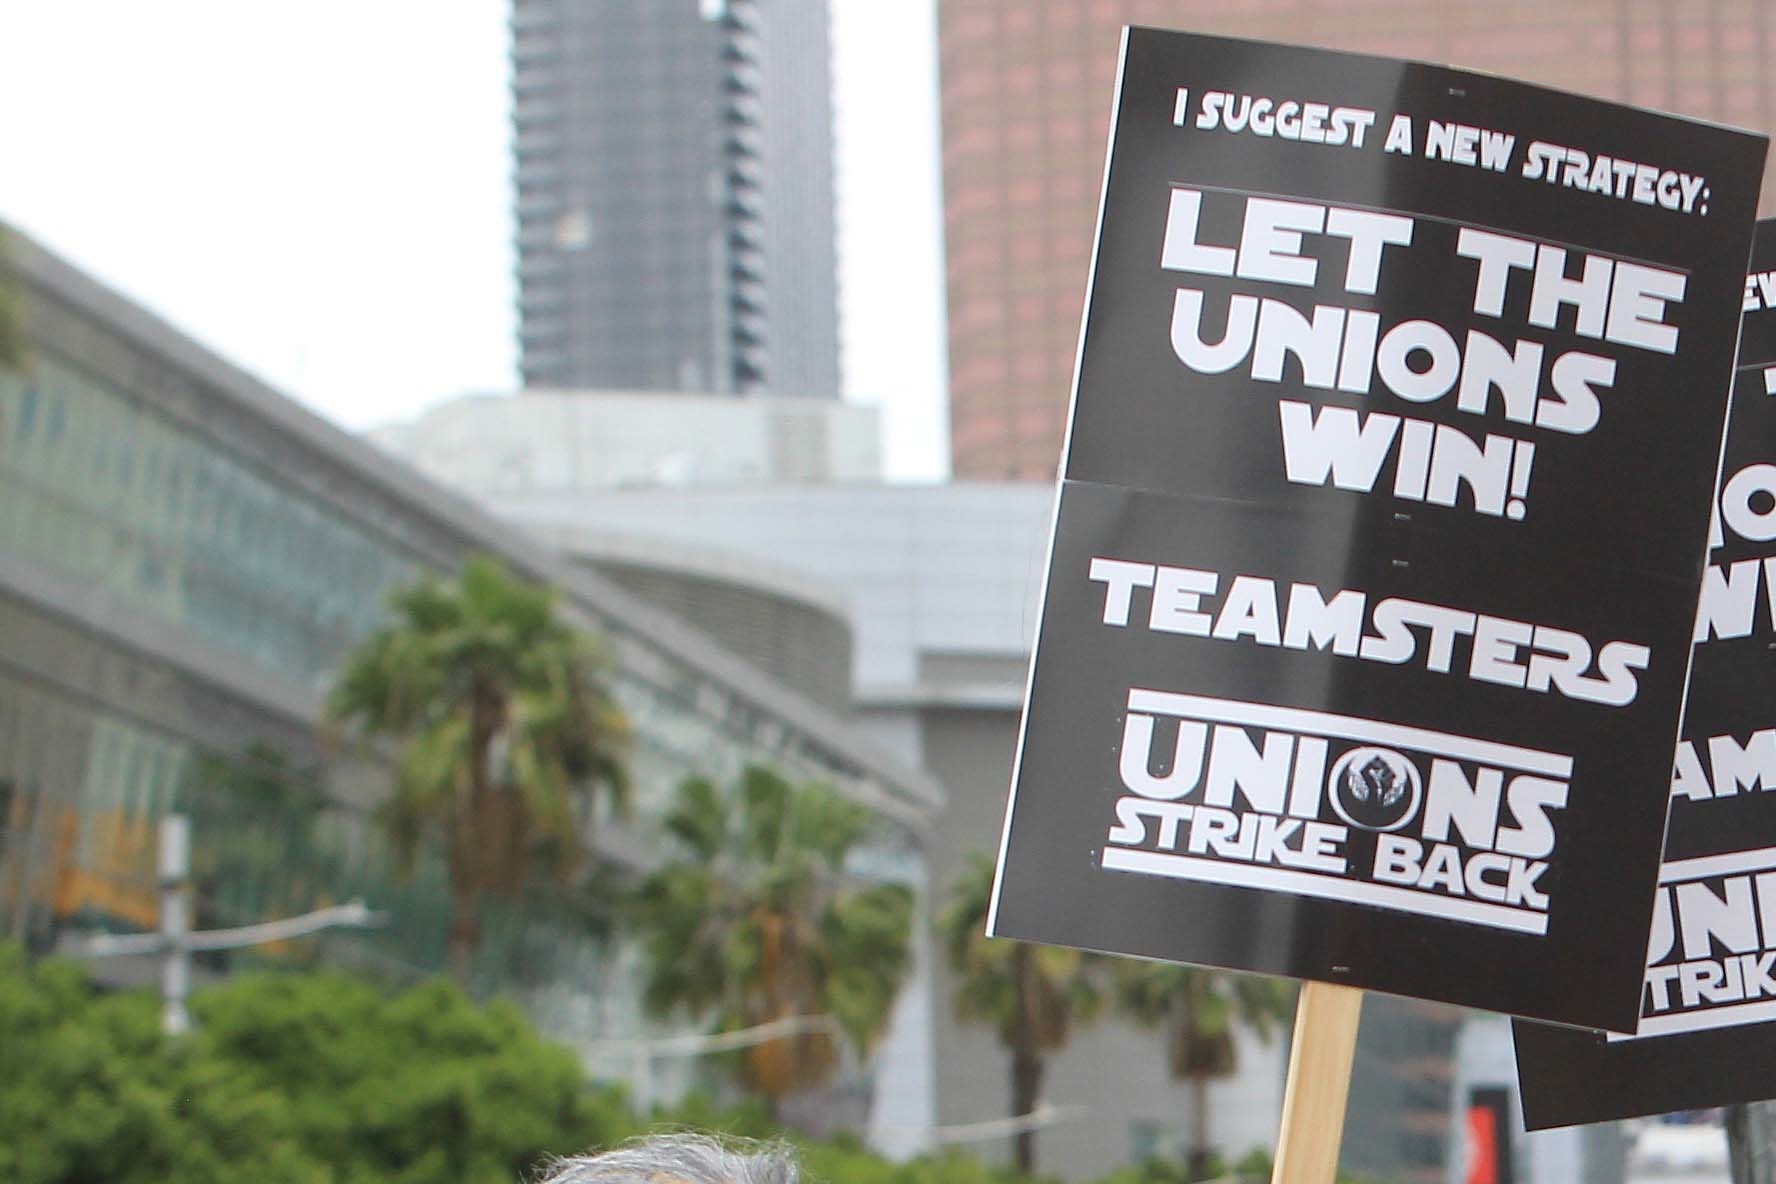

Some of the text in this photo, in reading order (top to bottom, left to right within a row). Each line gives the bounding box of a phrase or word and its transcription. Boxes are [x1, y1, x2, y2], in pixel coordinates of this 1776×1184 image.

[1172, 88, 1711, 215] I SUGGEST A NEW STRATEGY:
[1161, 188, 1687, 354] LET THE
[1171, 288, 1617, 434] UNIONS
[1280, 400, 1535, 520] WIN!
[1089, 557, 1650, 706] TEAMSTERS
[1110, 797, 1550, 910] STRIKE BACK
[1119, 713, 1572, 858] UNIONS
